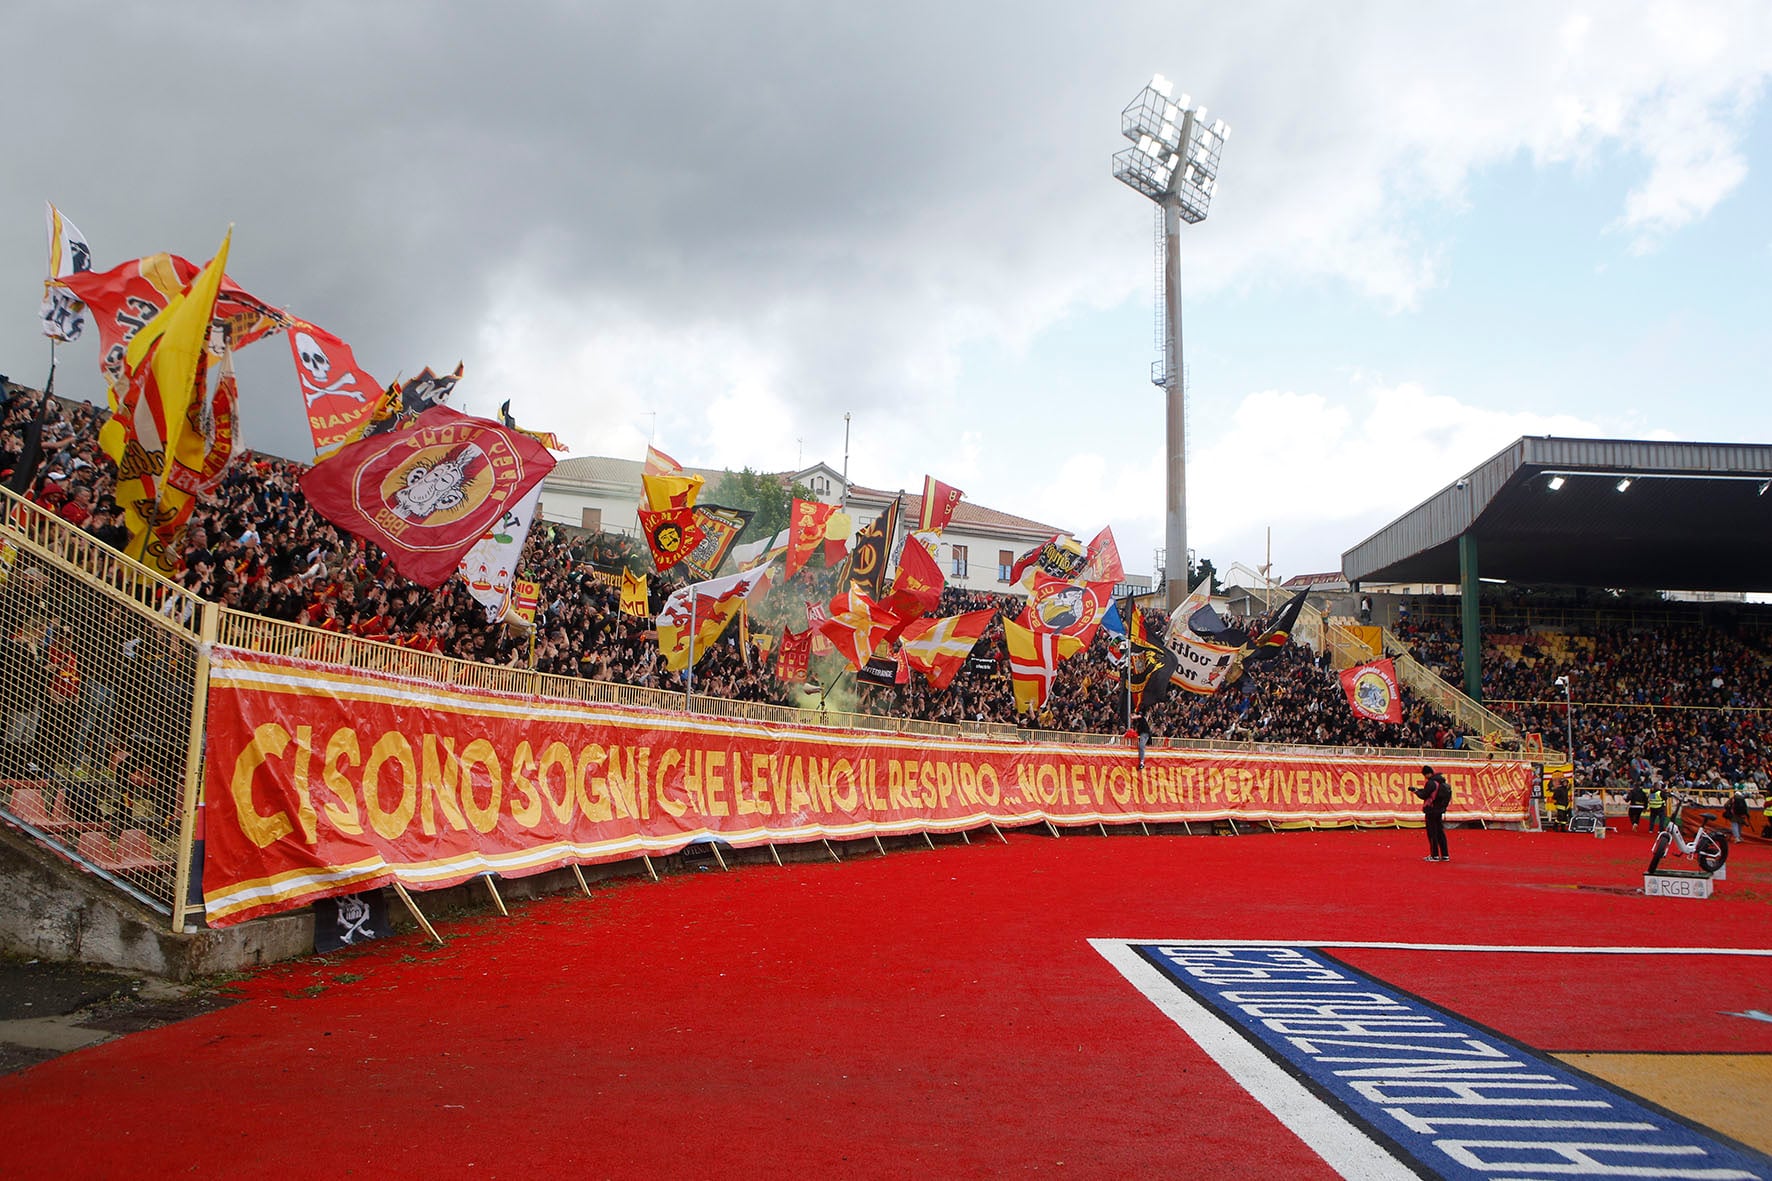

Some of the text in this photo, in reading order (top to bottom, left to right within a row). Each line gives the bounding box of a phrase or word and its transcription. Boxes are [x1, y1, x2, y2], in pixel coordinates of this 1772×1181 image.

[231, 722, 318, 848] CI
[322, 726, 502, 840] SONO
[510, 740, 651, 829] SOGNI
[656, 748, 730, 817] CHE
[733, 751, 858, 815] LEVANO
[860, 758, 888, 811] IL
[1016, 763, 1069, 805] NOI
[1071, 765, 1091, 805] E
[1089, 765, 1141, 805] VOI
[1142, 766, 1206, 804] UNITI
[1209, 767, 1255, 804] PER
[1255, 768, 1361, 805] VIVERLO
[1363, 771, 1475, 805] INSIEE!
[1661, 880, 1690, 896] RGB
[1158, 947, 1763, 1181] ATANZARO 1929
